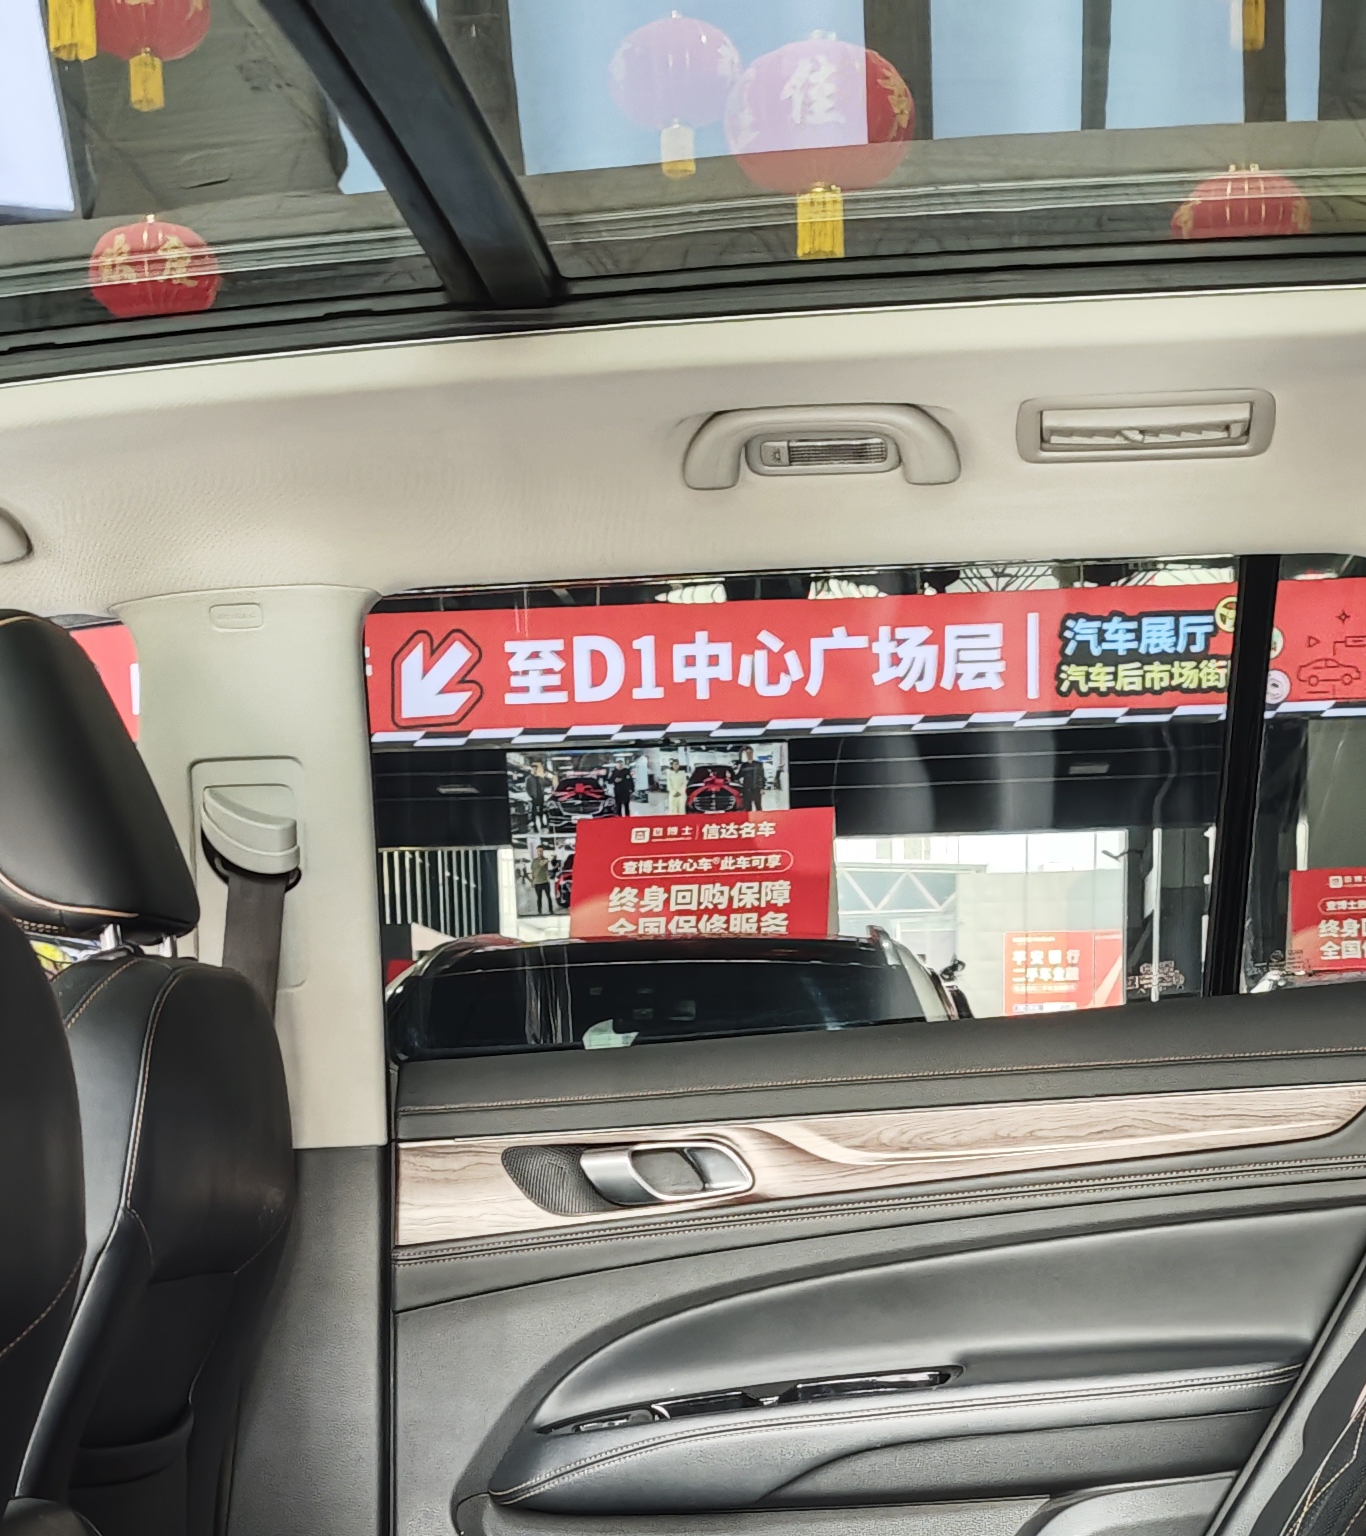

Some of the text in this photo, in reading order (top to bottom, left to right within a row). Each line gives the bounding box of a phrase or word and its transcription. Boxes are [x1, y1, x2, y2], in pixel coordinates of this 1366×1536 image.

[780, 53, 846, 125] 佳
[1062, 615, 1215, 657] 汽车展厅
[503, 622, 1007, 706] 至D1中心广场层
[1059, 659, 1232, 693] 汽车后市场街
[701, 821, 776, 840] 信达名车
[608, 880, 791, 914] 终身回购保障
